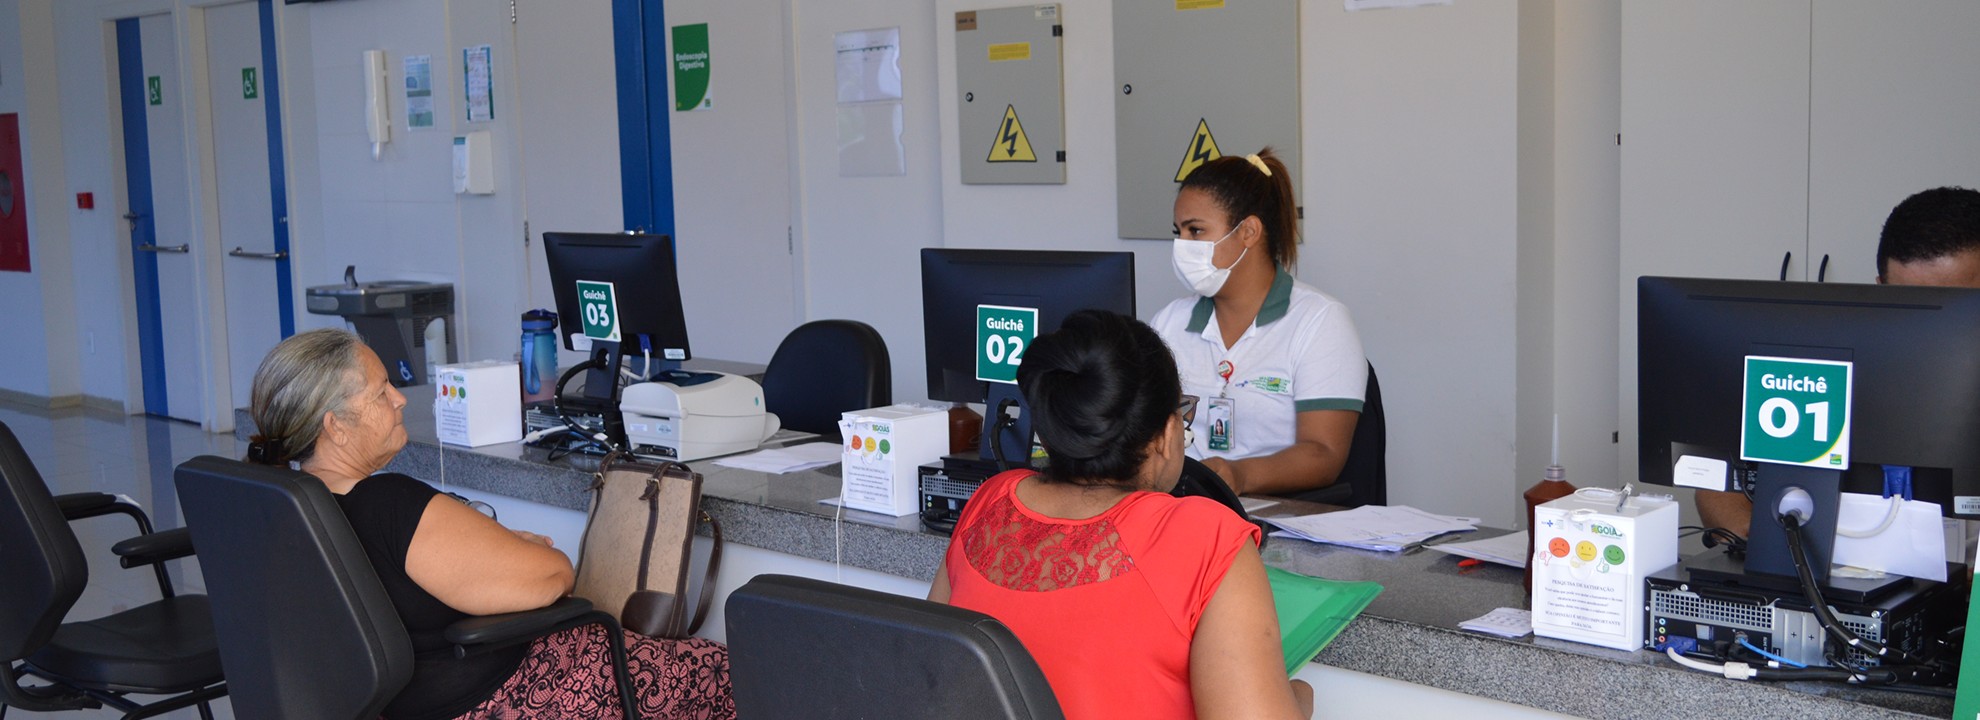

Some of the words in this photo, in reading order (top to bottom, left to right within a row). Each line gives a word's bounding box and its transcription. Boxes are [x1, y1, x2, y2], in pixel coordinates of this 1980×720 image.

[676, 50, 707, 61] Endoscopia
[679, 60, 705, 71] Digestiva
[583, 290, 606, 300] Guichê
[586, 302, 610, 327] 03
[986, 317, 1024, 331] Guichê
[986, 334, 1024, 366] 02
[1761, 373, 1827, 393] Guichê
[1758, 397, 1829, 442] 01
